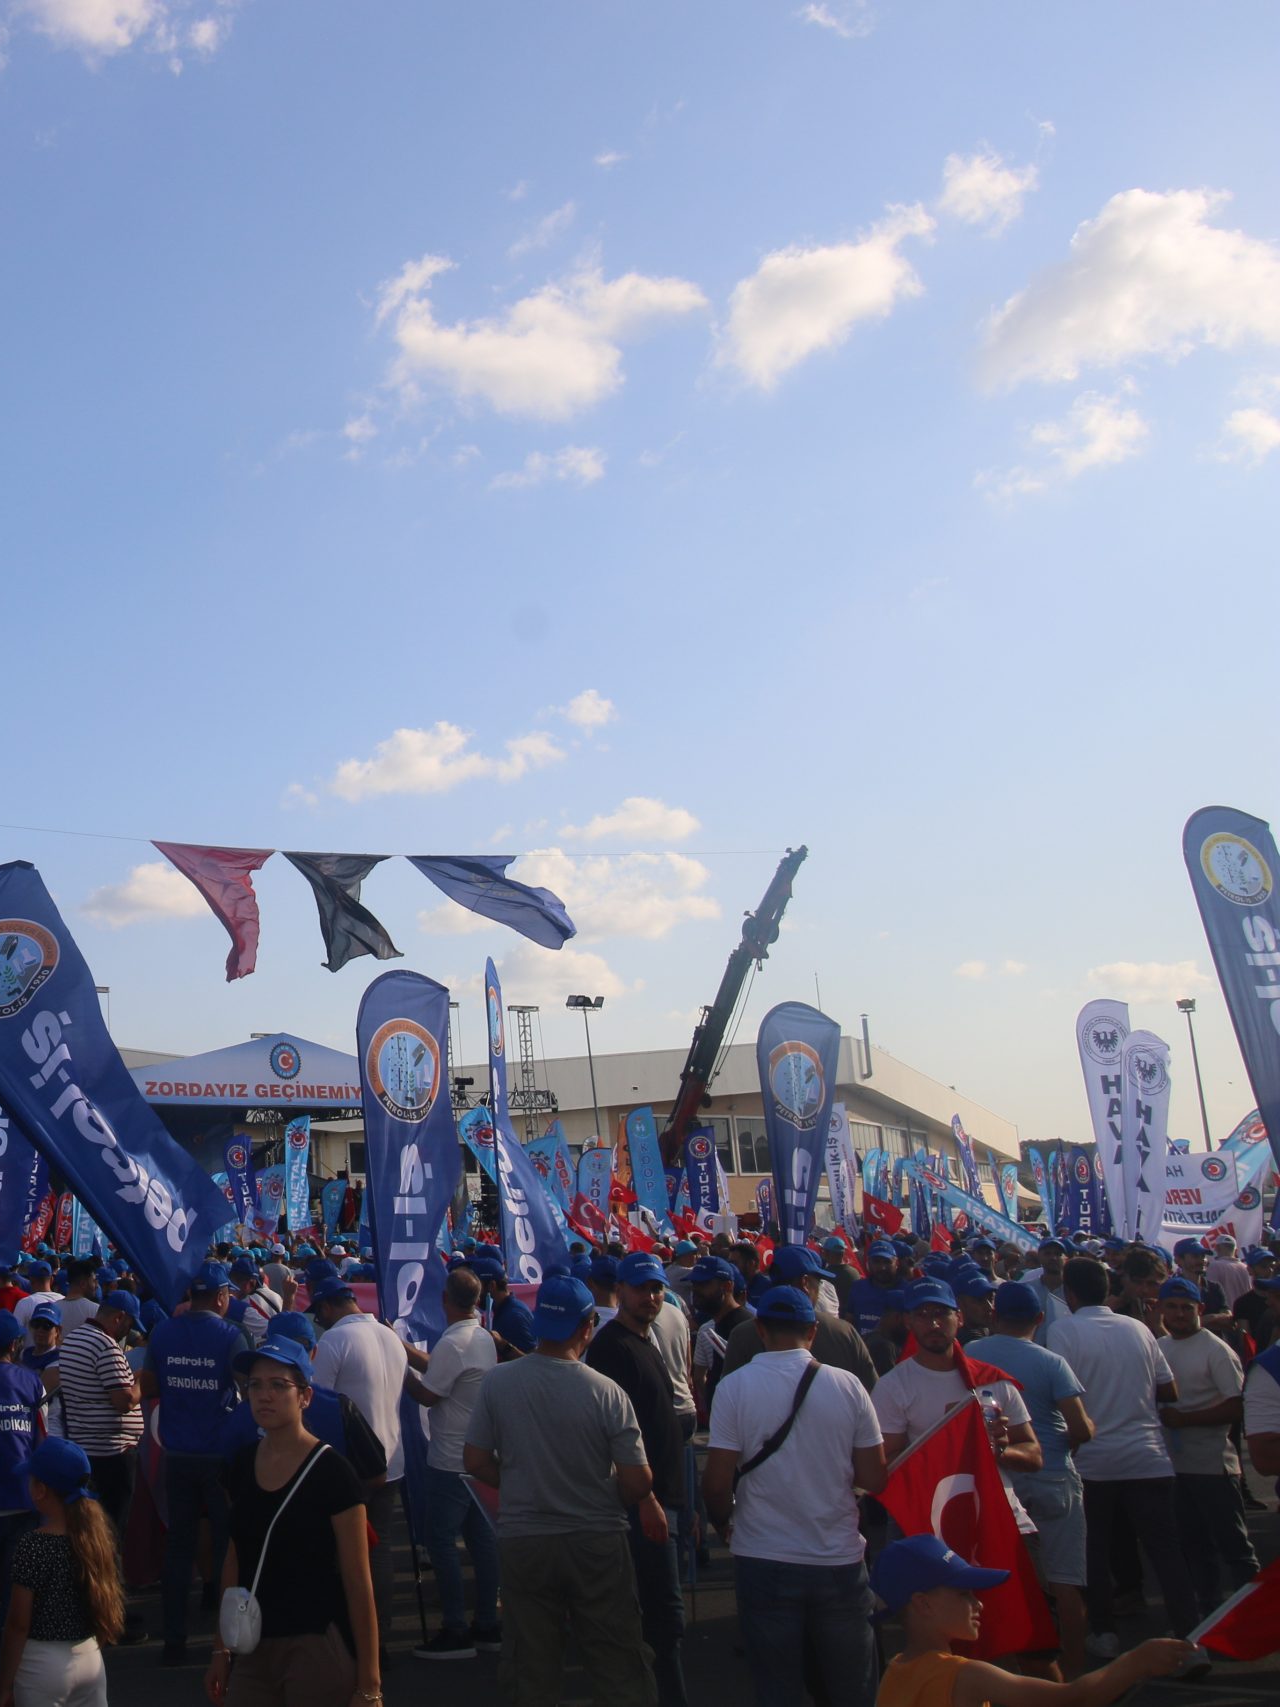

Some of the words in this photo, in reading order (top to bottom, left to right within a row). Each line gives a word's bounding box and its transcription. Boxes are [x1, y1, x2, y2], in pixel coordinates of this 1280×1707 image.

[29, 968, 51, 990] 1950
[145, 1081, 248, 1098] ZORDAYIZ
[254, 1081, 362, 1103] GEÇİNEMİY
[696, 1161, 712, 1209] TÜRK
[78, 1213, 92, 1253] ETAL
[166, 1355, 217, 1369] petrol-iş
[166, 1375, 219, 1391] SENDİKASI
